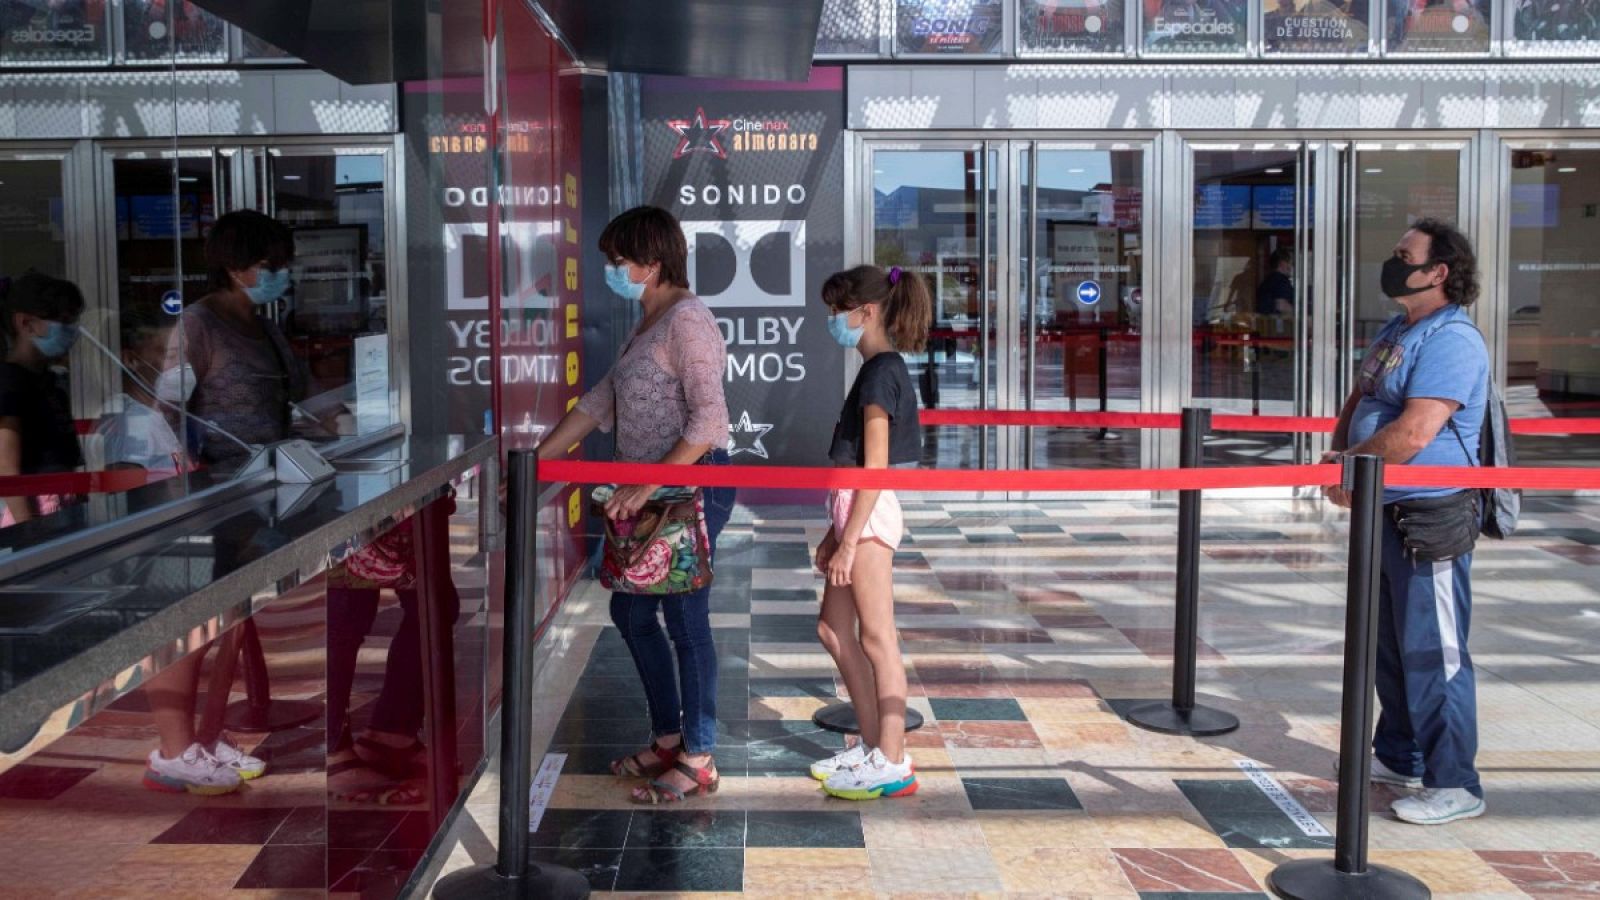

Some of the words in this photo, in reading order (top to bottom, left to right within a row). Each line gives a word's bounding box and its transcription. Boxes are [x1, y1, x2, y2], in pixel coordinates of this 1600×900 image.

[1154, 17, 1235, 39] Especiales
[1276, 27, 1293, 37] DE
[1298, 27, 1353, 39] JUSTICIA
[1284, 16, 1348, 29] CUESTIÓN
[733, 131, 818, 151] almenara
[679, 184, 807, 205] SONIDO
[714, 317, 805, 345] OLBY
[727, 352, 806, 383] MOS
